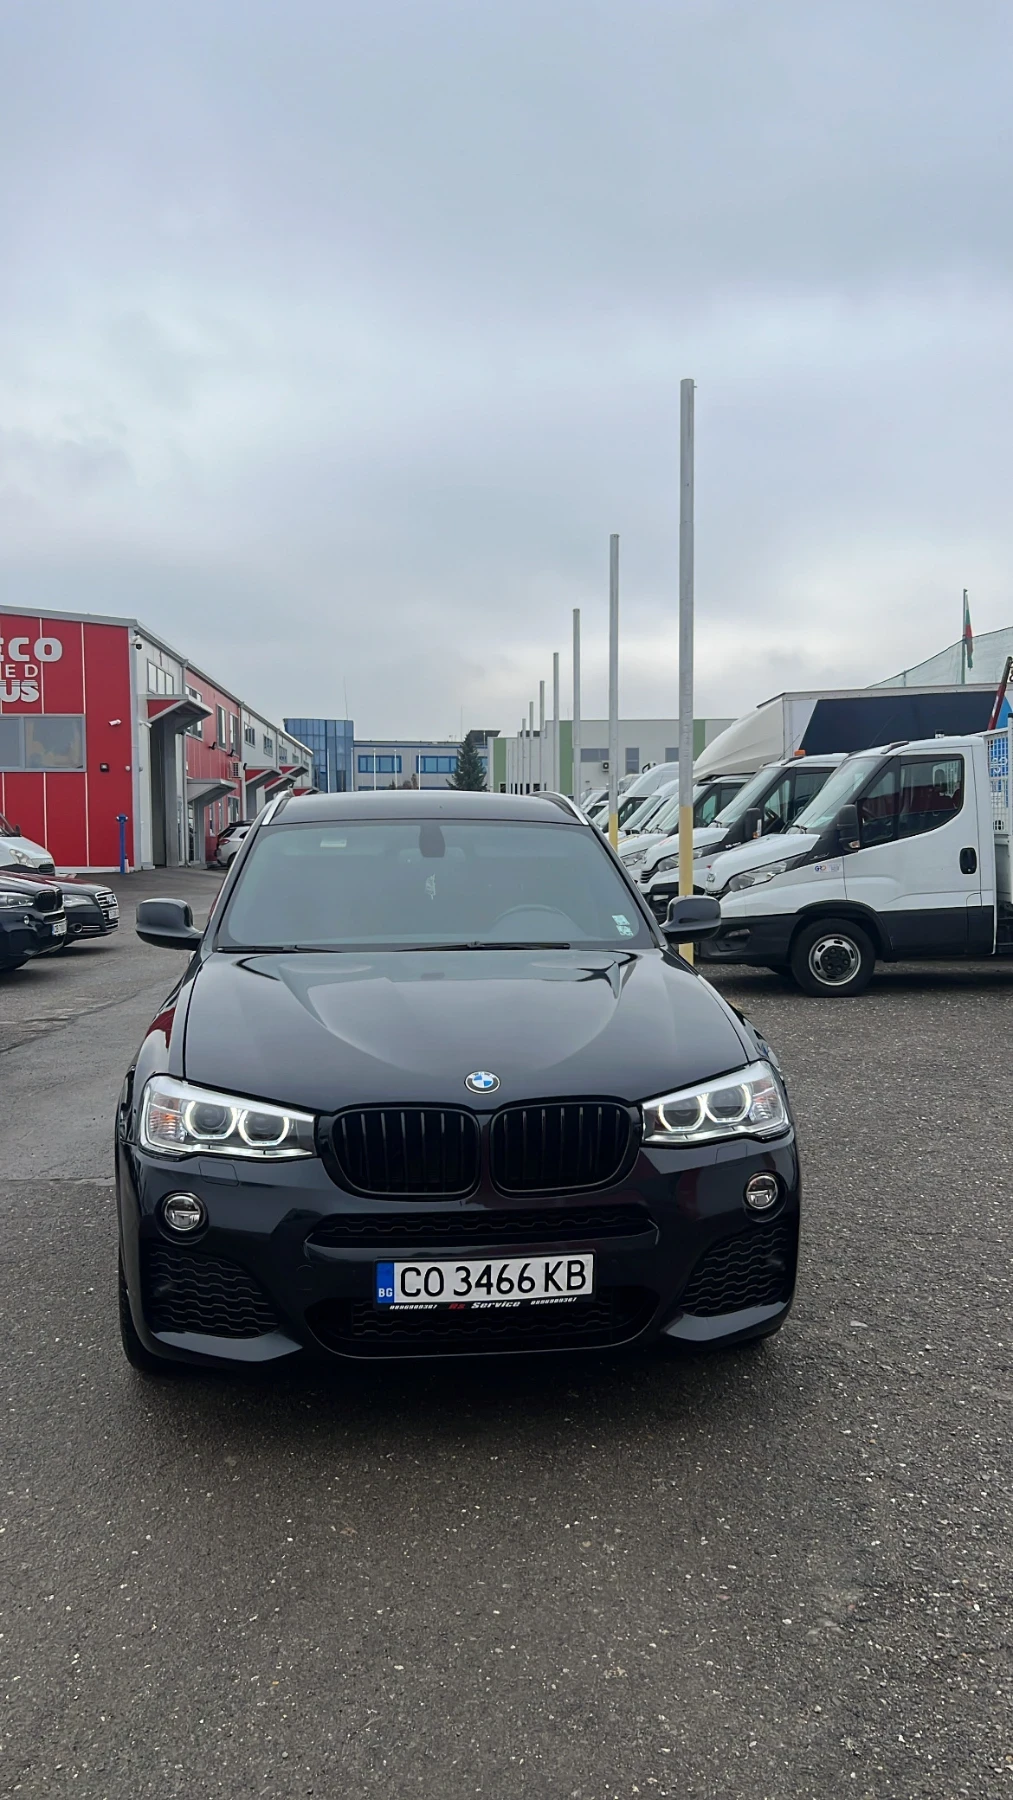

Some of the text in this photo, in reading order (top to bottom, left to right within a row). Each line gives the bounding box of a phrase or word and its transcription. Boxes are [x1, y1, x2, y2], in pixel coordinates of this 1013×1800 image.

[0, 637, 63, 662] CO
[400, 1259, 586, 1297] CO 3466 KB
[378, 1288, 393, 1298] BG
[470, 1301, 521, 1309] Service
